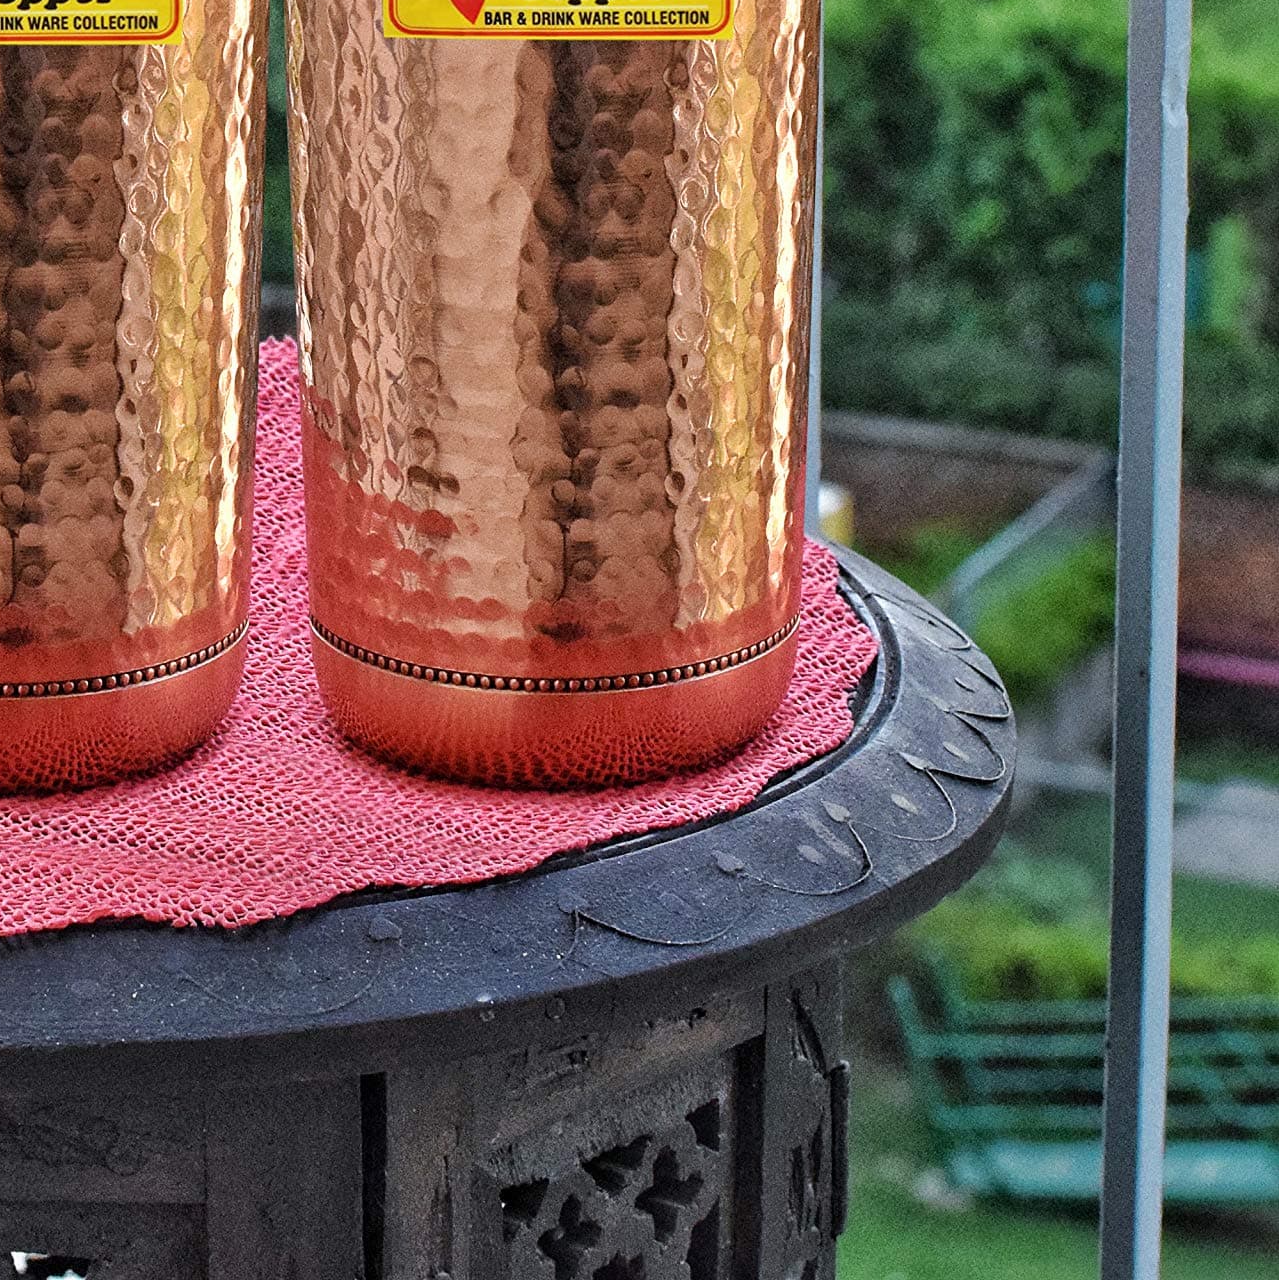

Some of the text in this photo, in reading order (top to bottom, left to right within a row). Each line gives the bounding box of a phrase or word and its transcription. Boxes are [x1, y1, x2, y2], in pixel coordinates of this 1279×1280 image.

[27, 15, 69, 31] WARE
[73, 15, 159, 31] COLLECTION
[484, 10, 710, 26] BAR & DRINK WARE COLLECTION
